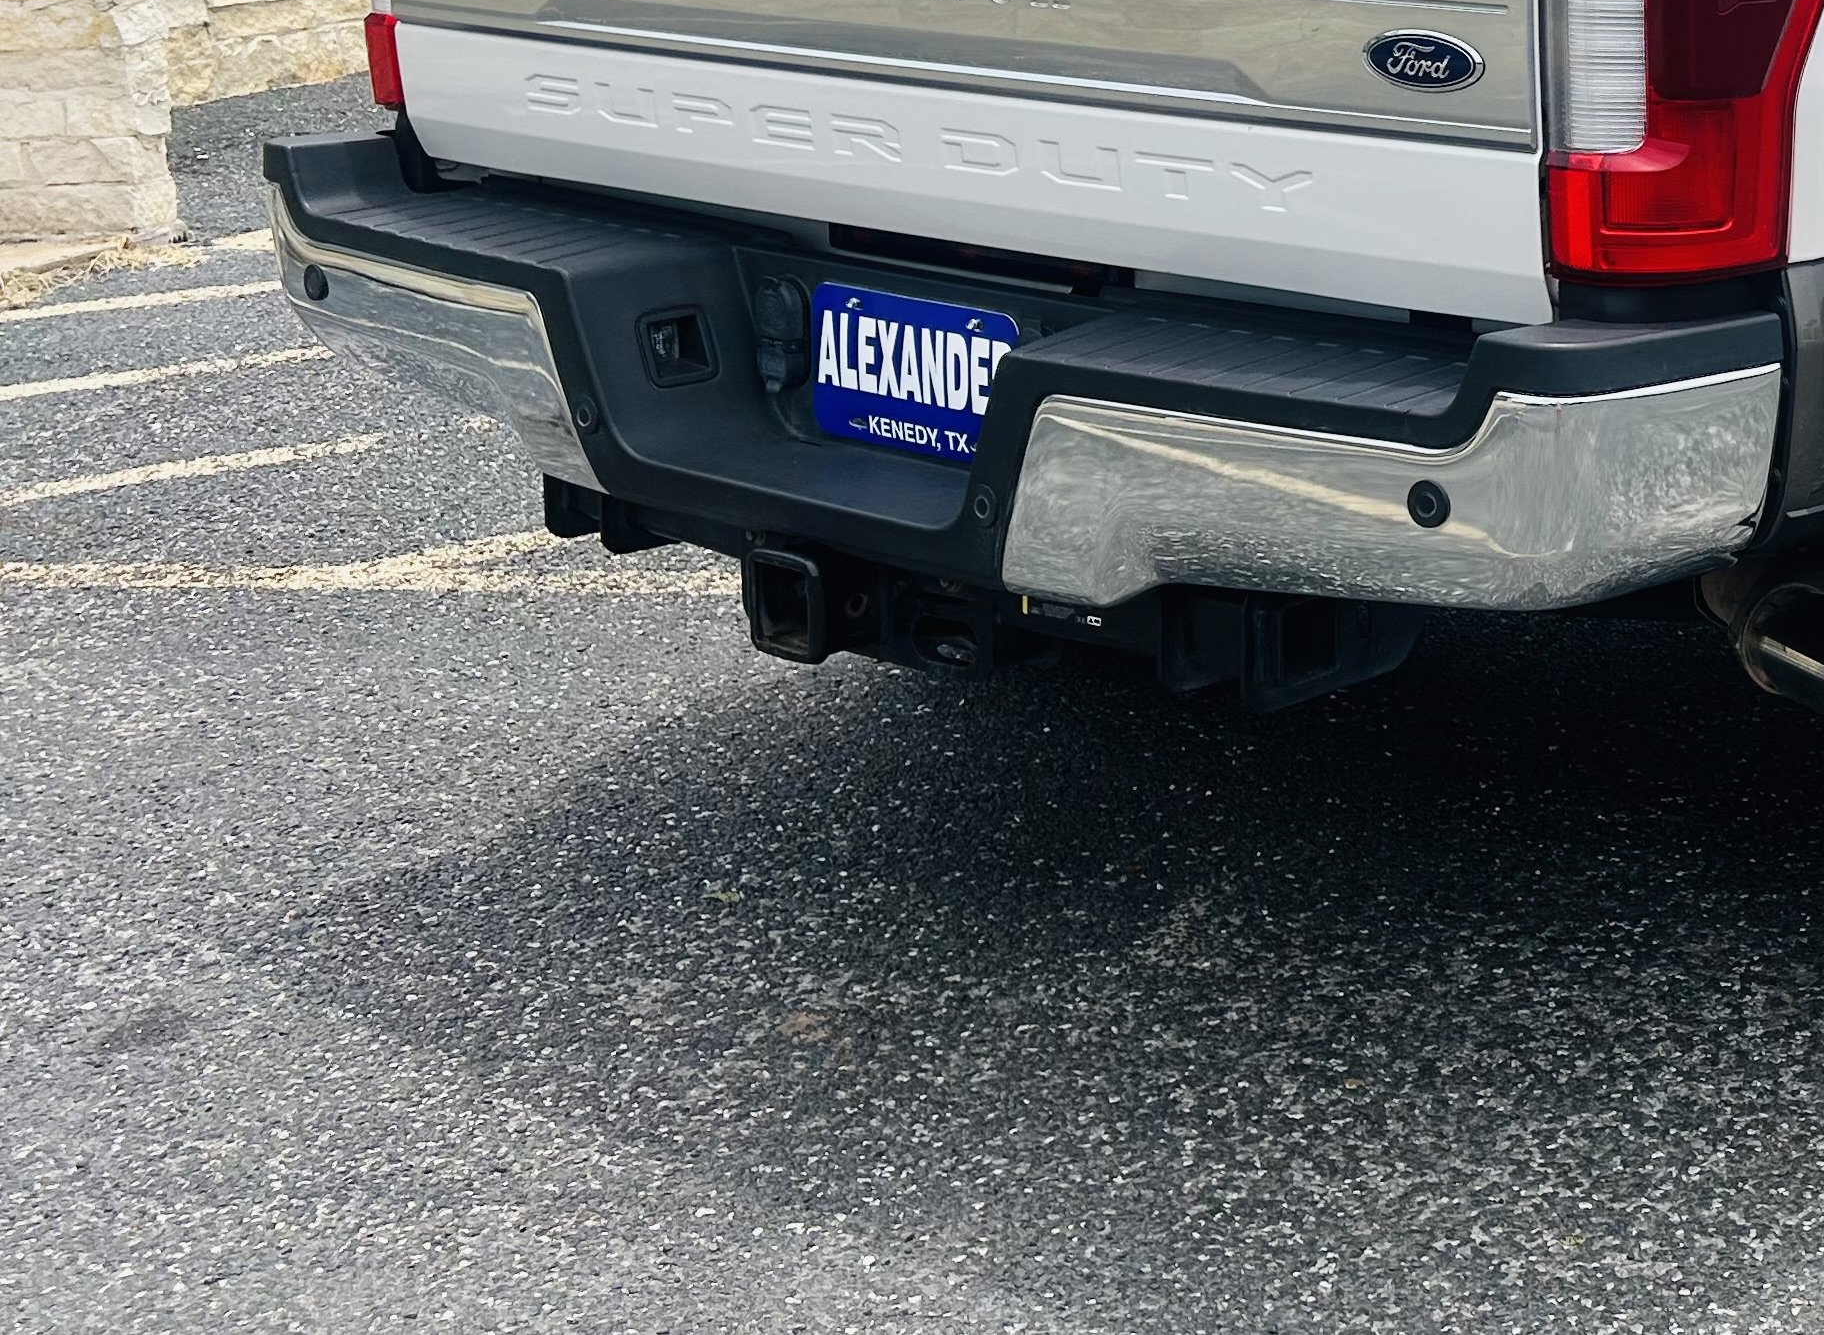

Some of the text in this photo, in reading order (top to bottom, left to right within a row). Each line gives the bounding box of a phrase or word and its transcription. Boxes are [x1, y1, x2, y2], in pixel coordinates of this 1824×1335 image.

[1385, 40, 1451, 80] Ford
[525, 74, 1314, 213] SUPER DUTY
[868, 416, 969, 453] KENEDY, TX
